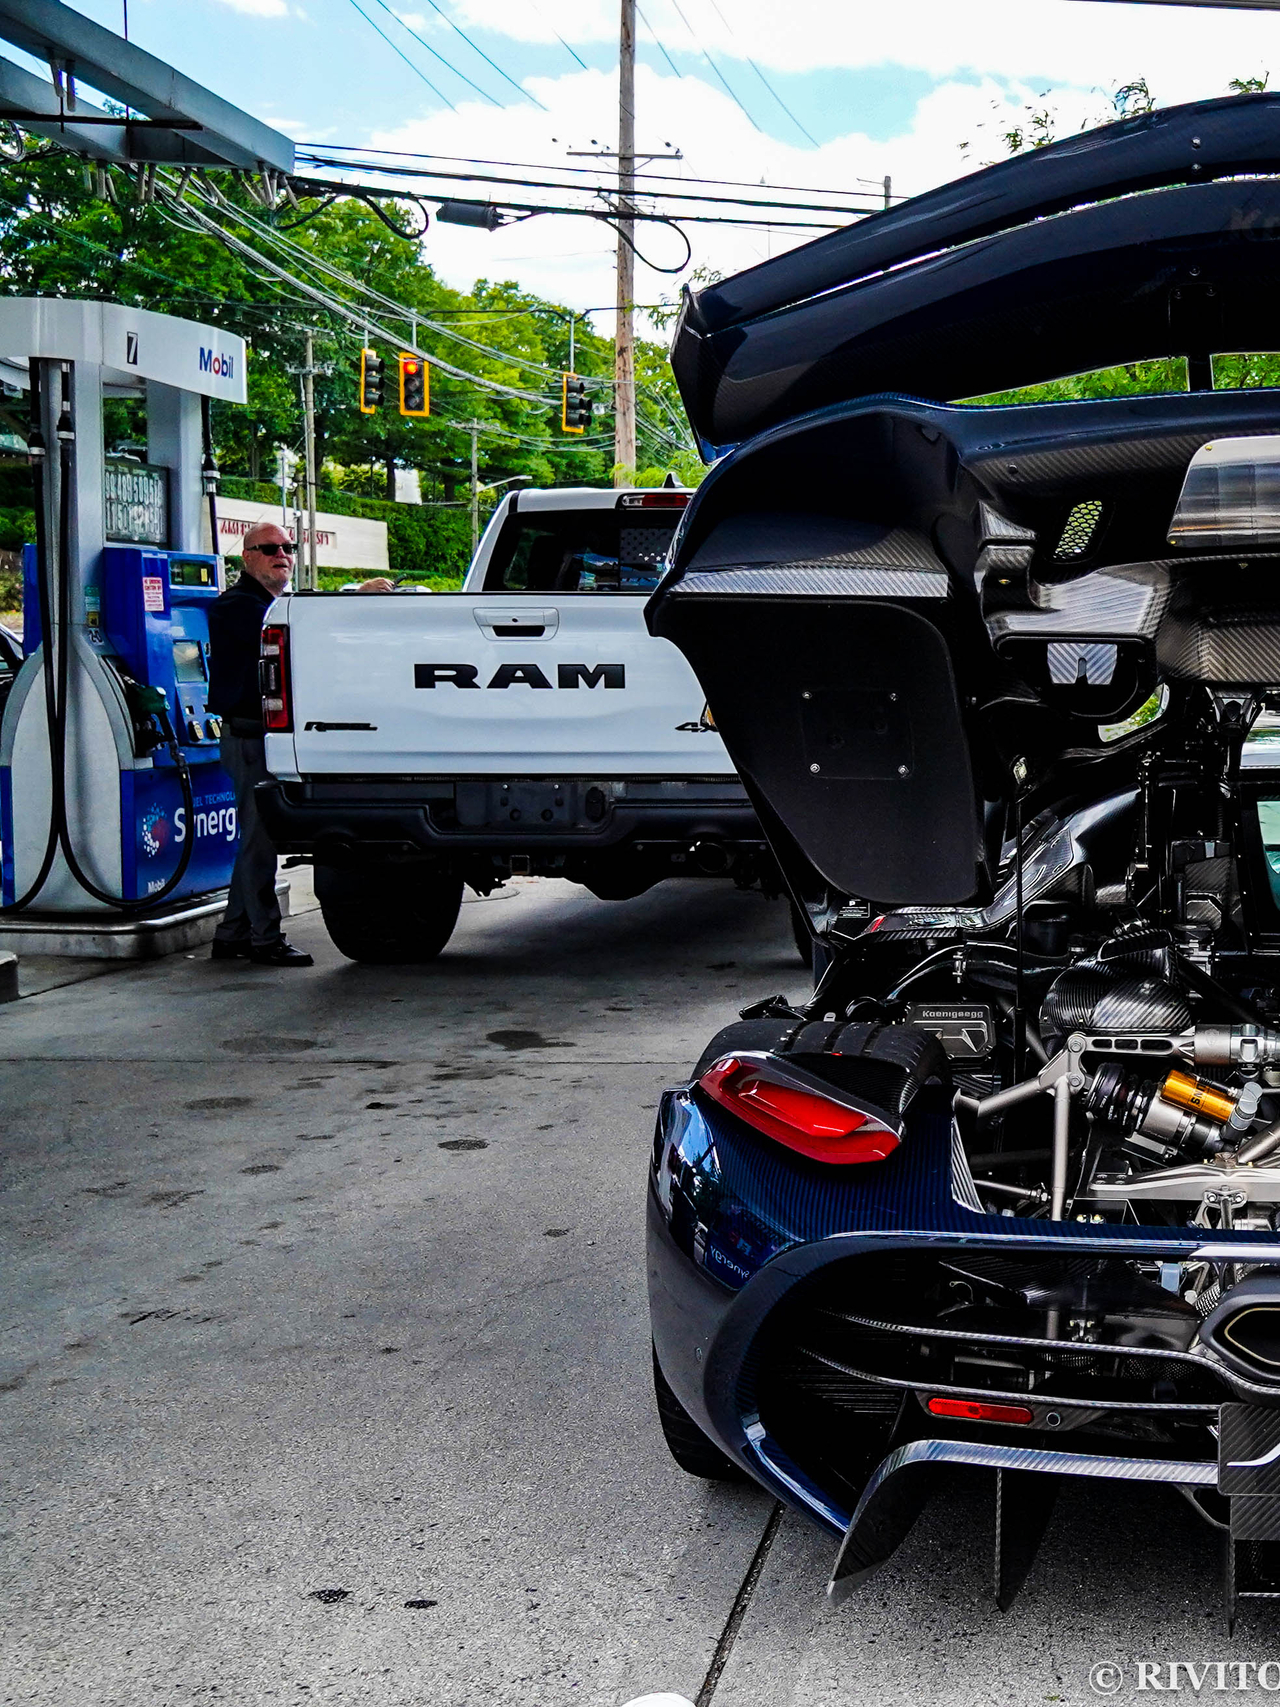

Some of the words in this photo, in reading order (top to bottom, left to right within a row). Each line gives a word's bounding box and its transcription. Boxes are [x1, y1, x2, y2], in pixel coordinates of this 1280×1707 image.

[128, 332, 138, 364] 7
[200, 347, 234, 380] Mobil
[414, 663, 626, 689] RAM
[922, 1009, 984, 1019] Koenigsegg
